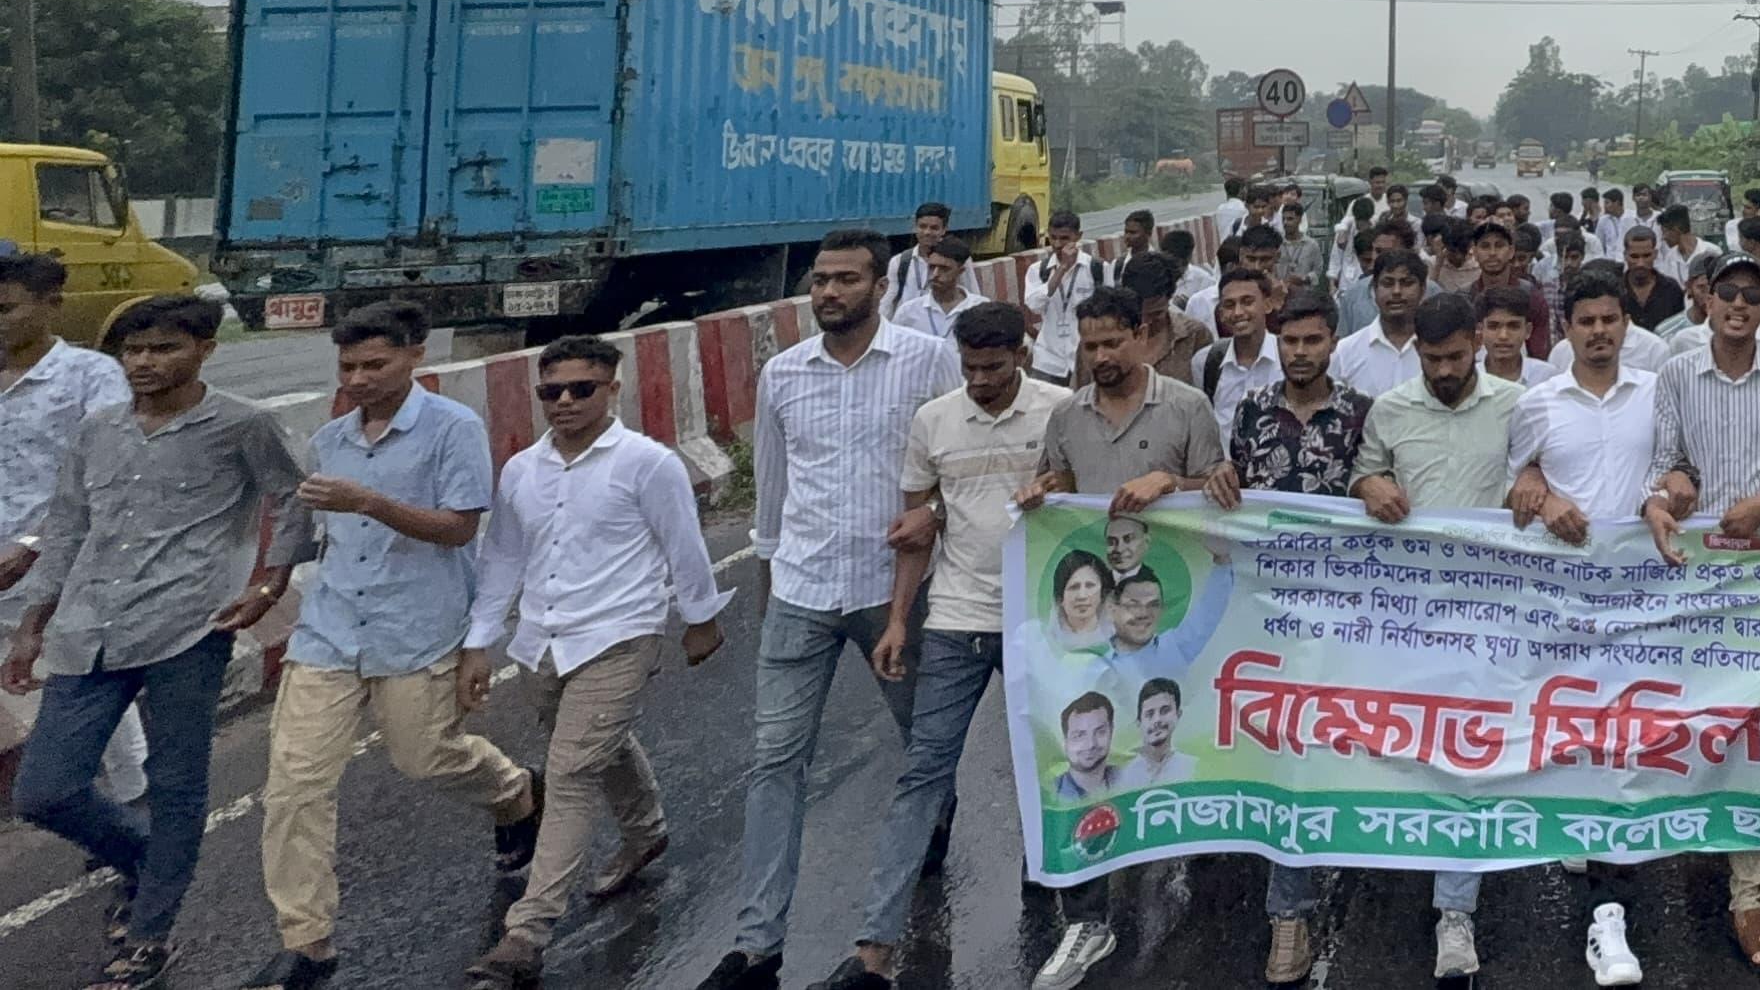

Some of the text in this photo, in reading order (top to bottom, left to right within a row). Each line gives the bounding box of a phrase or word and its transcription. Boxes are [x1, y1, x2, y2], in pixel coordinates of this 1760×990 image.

[1265, 80, 1299, 106] 40
[269, 298, 321, 321] থামুন
[1256, 554, 1314, 578] শিকার
[1325, 555, 1431, 585] ভিকটিমদের
[1439, 570, 1523, 594] অবমাননা
[1579, 589, 1668, 610] অনলাইনে
[1342, 531, 1394, 561] কর্তৃক
[1404, 539, 1430, 557] গুম
[1440, 543, 1455, 558] ও
[1463, 544, 1556, 574] অপহরণের
[1563, 559, 1613, 582] নাটক
[1696, 563, 1743, 589] প্রকৃত
[1271, 587, 1363, 611] সরকারকে
[1371, 587, 1417, 615] মিথ্যা
[1426, 597, 1516, 624] দোষারোপ
[1525, 609, 1560, 633] এবং
[1264, 613, 1301, 639] ধর্ষণ
[1310, 623, 1324, 639] ও
[1333, 614, 1373, 645] নারী
[1381, 619, 1477, 656] নির্যাতনসহ
[1485, 636, 1520, 665] ঘৃণ্য
[1527, 640, 1591, 663] অপরাধ
[1213, 651, 1513, 771] বিক্ষোভ
[1130, 789, 1339, 854] নিজামপুর
[1355, 800, 1543, 850] সরকারি
[1559, 806, 1710, 853] কলেজ
